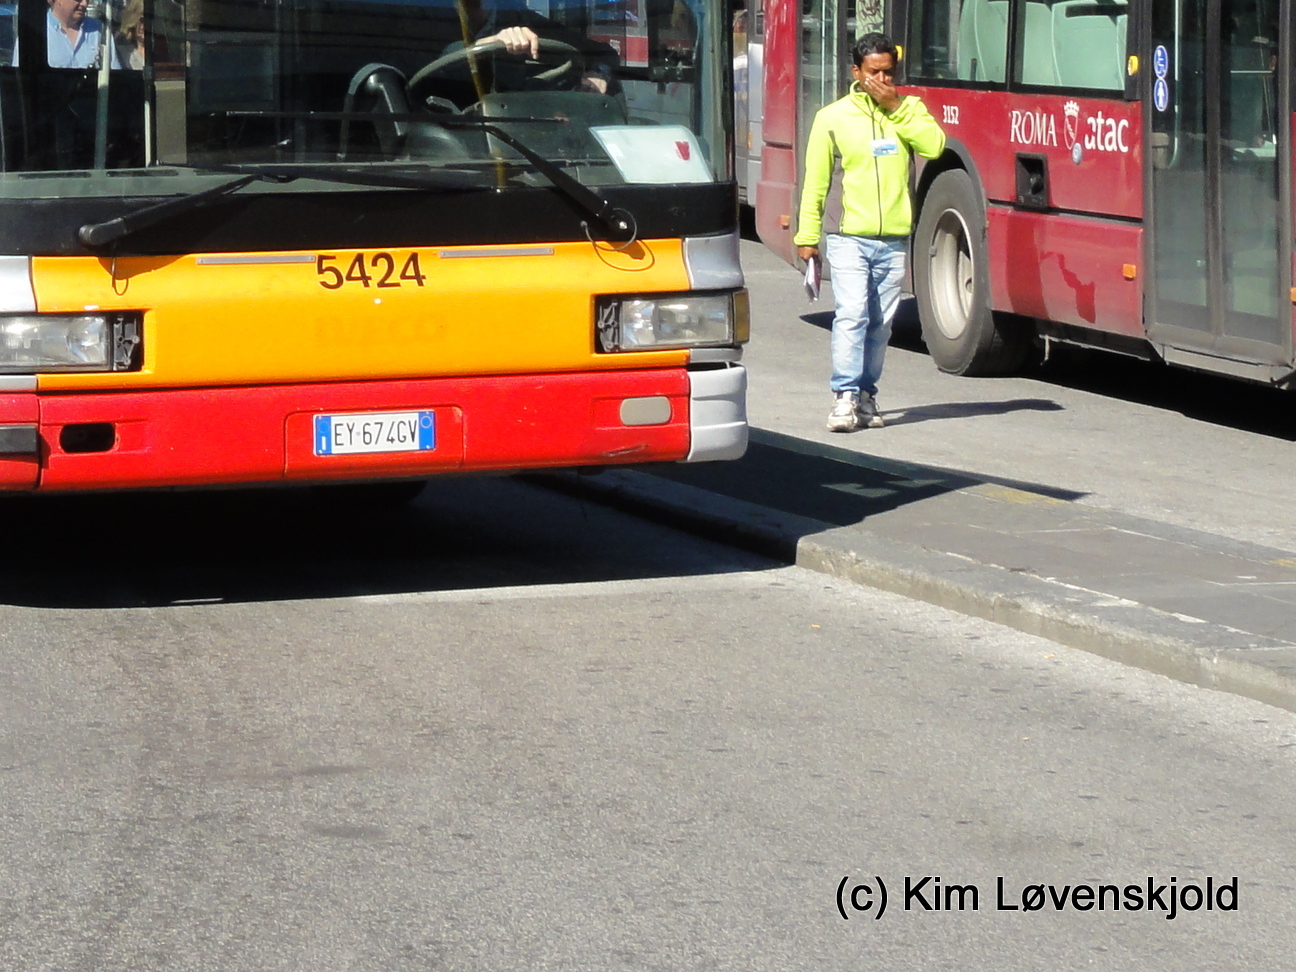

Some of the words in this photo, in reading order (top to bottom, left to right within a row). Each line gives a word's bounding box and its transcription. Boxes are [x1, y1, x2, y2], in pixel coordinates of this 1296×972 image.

[942, 104, 959, 125] 3152
[1010, 110, 1058, 146] ROMA
[1084, 110, 1129, 152] atac
[316, 252, 427, 290] 5424
